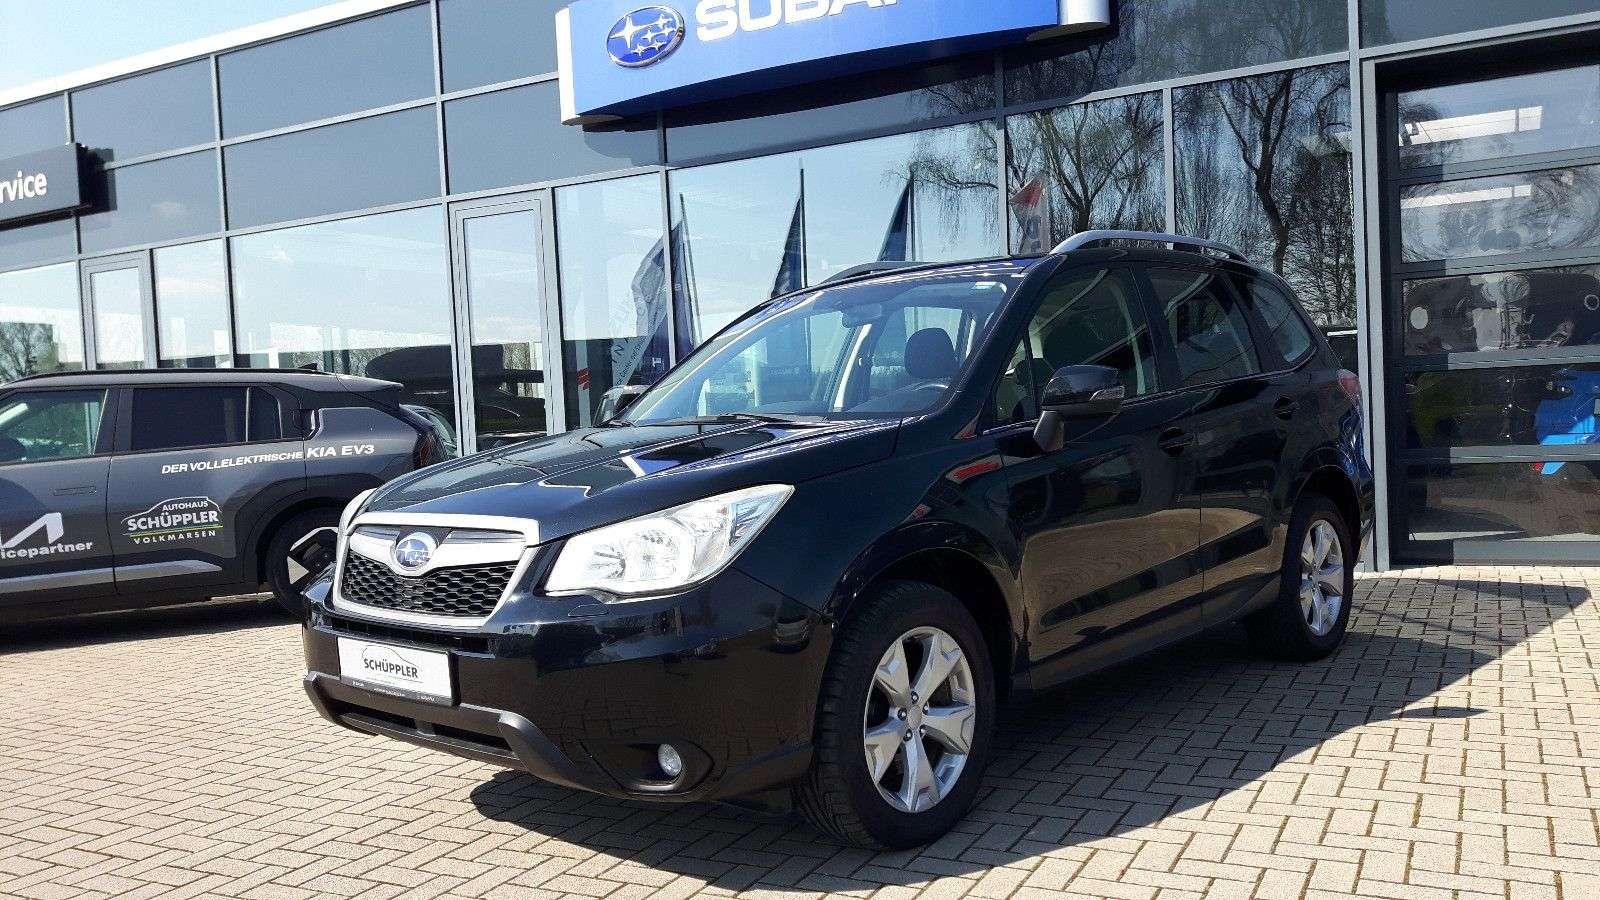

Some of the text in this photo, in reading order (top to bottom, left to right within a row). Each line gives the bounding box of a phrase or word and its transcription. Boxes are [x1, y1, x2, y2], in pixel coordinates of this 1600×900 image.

[161, 445, 375, 474] DER VOLLELEKTRISCHE KIA EV3
[162, 501, 208, 512] AUTOHAUS
[127, 510, 219, 531] SCHÜPPLER
[133, 530, 216, 545] VOLKMARSEN
[363, 658, 419, 679] SCHÜPPLER
